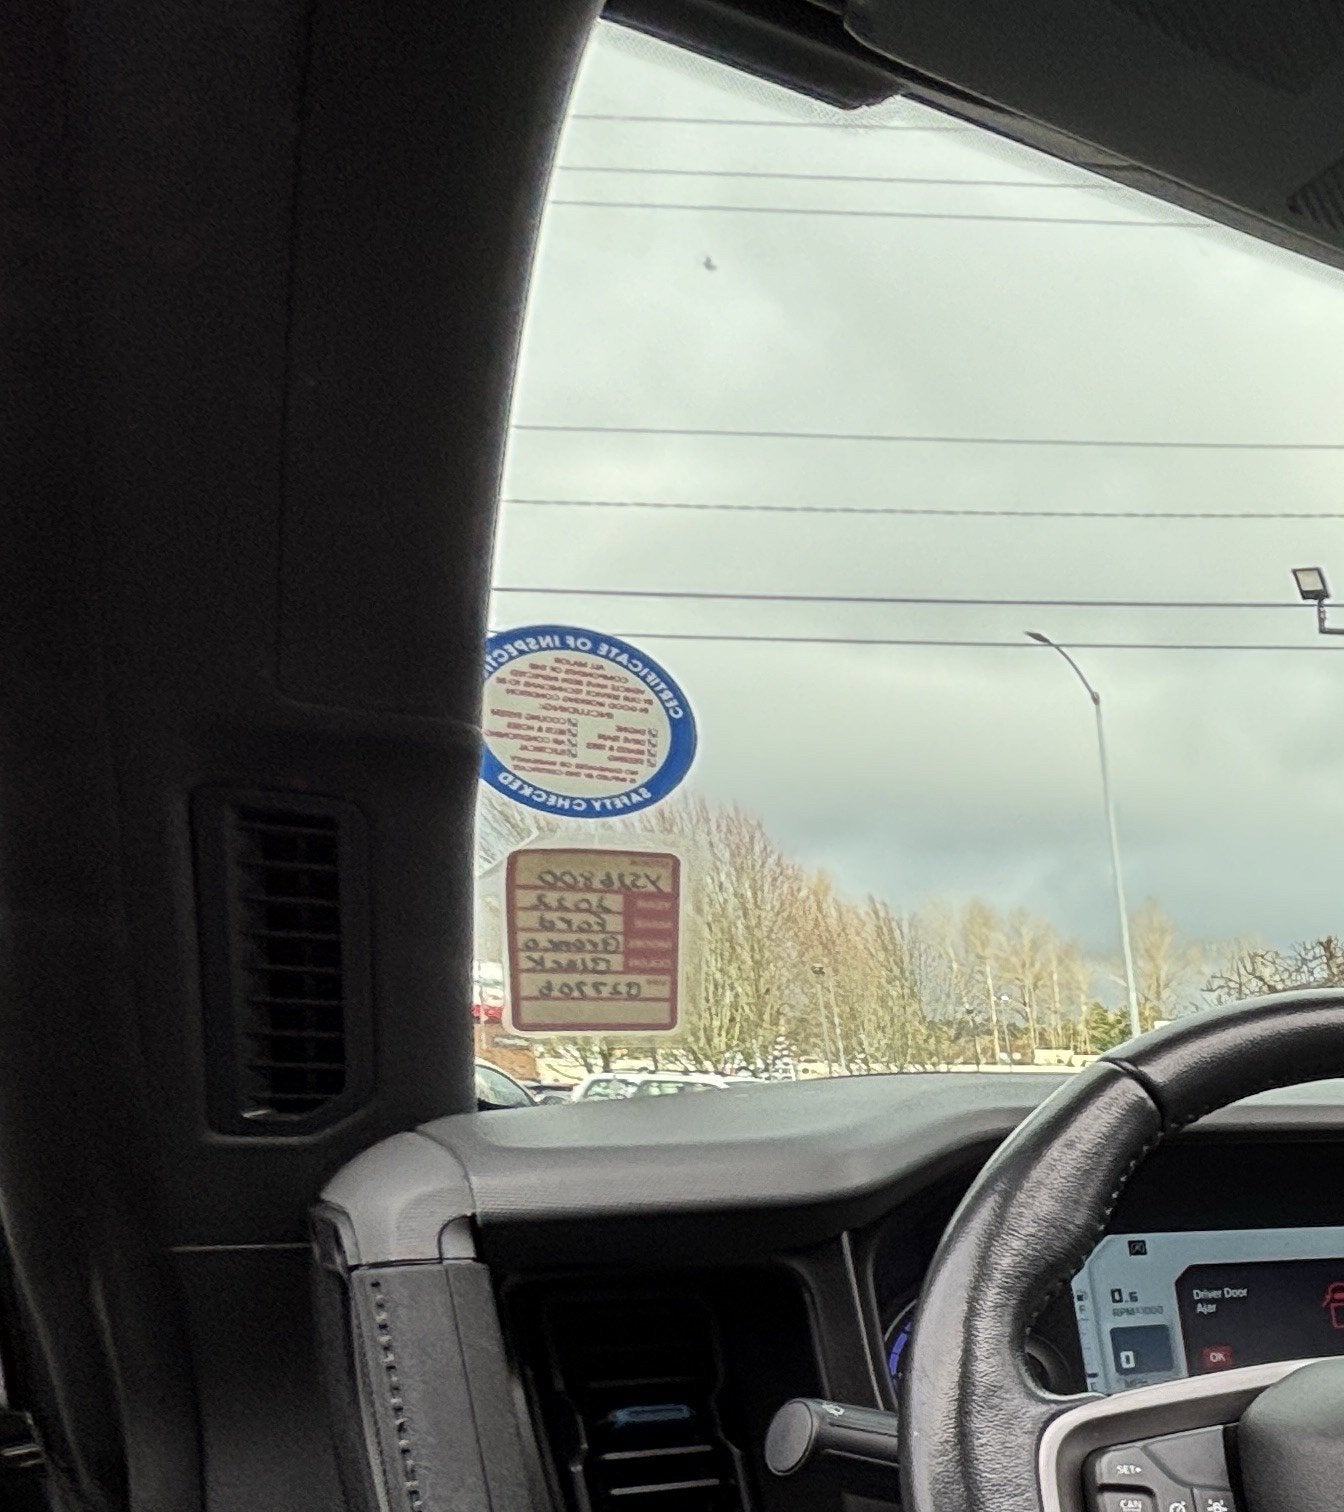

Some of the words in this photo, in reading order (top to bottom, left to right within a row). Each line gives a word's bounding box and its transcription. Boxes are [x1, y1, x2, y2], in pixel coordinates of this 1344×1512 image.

[1192, 1289, 1222, 1300] Driver
[1223, 1287, 1248, 1298] Door
[1209, 1352, 1226, 1363] OK
